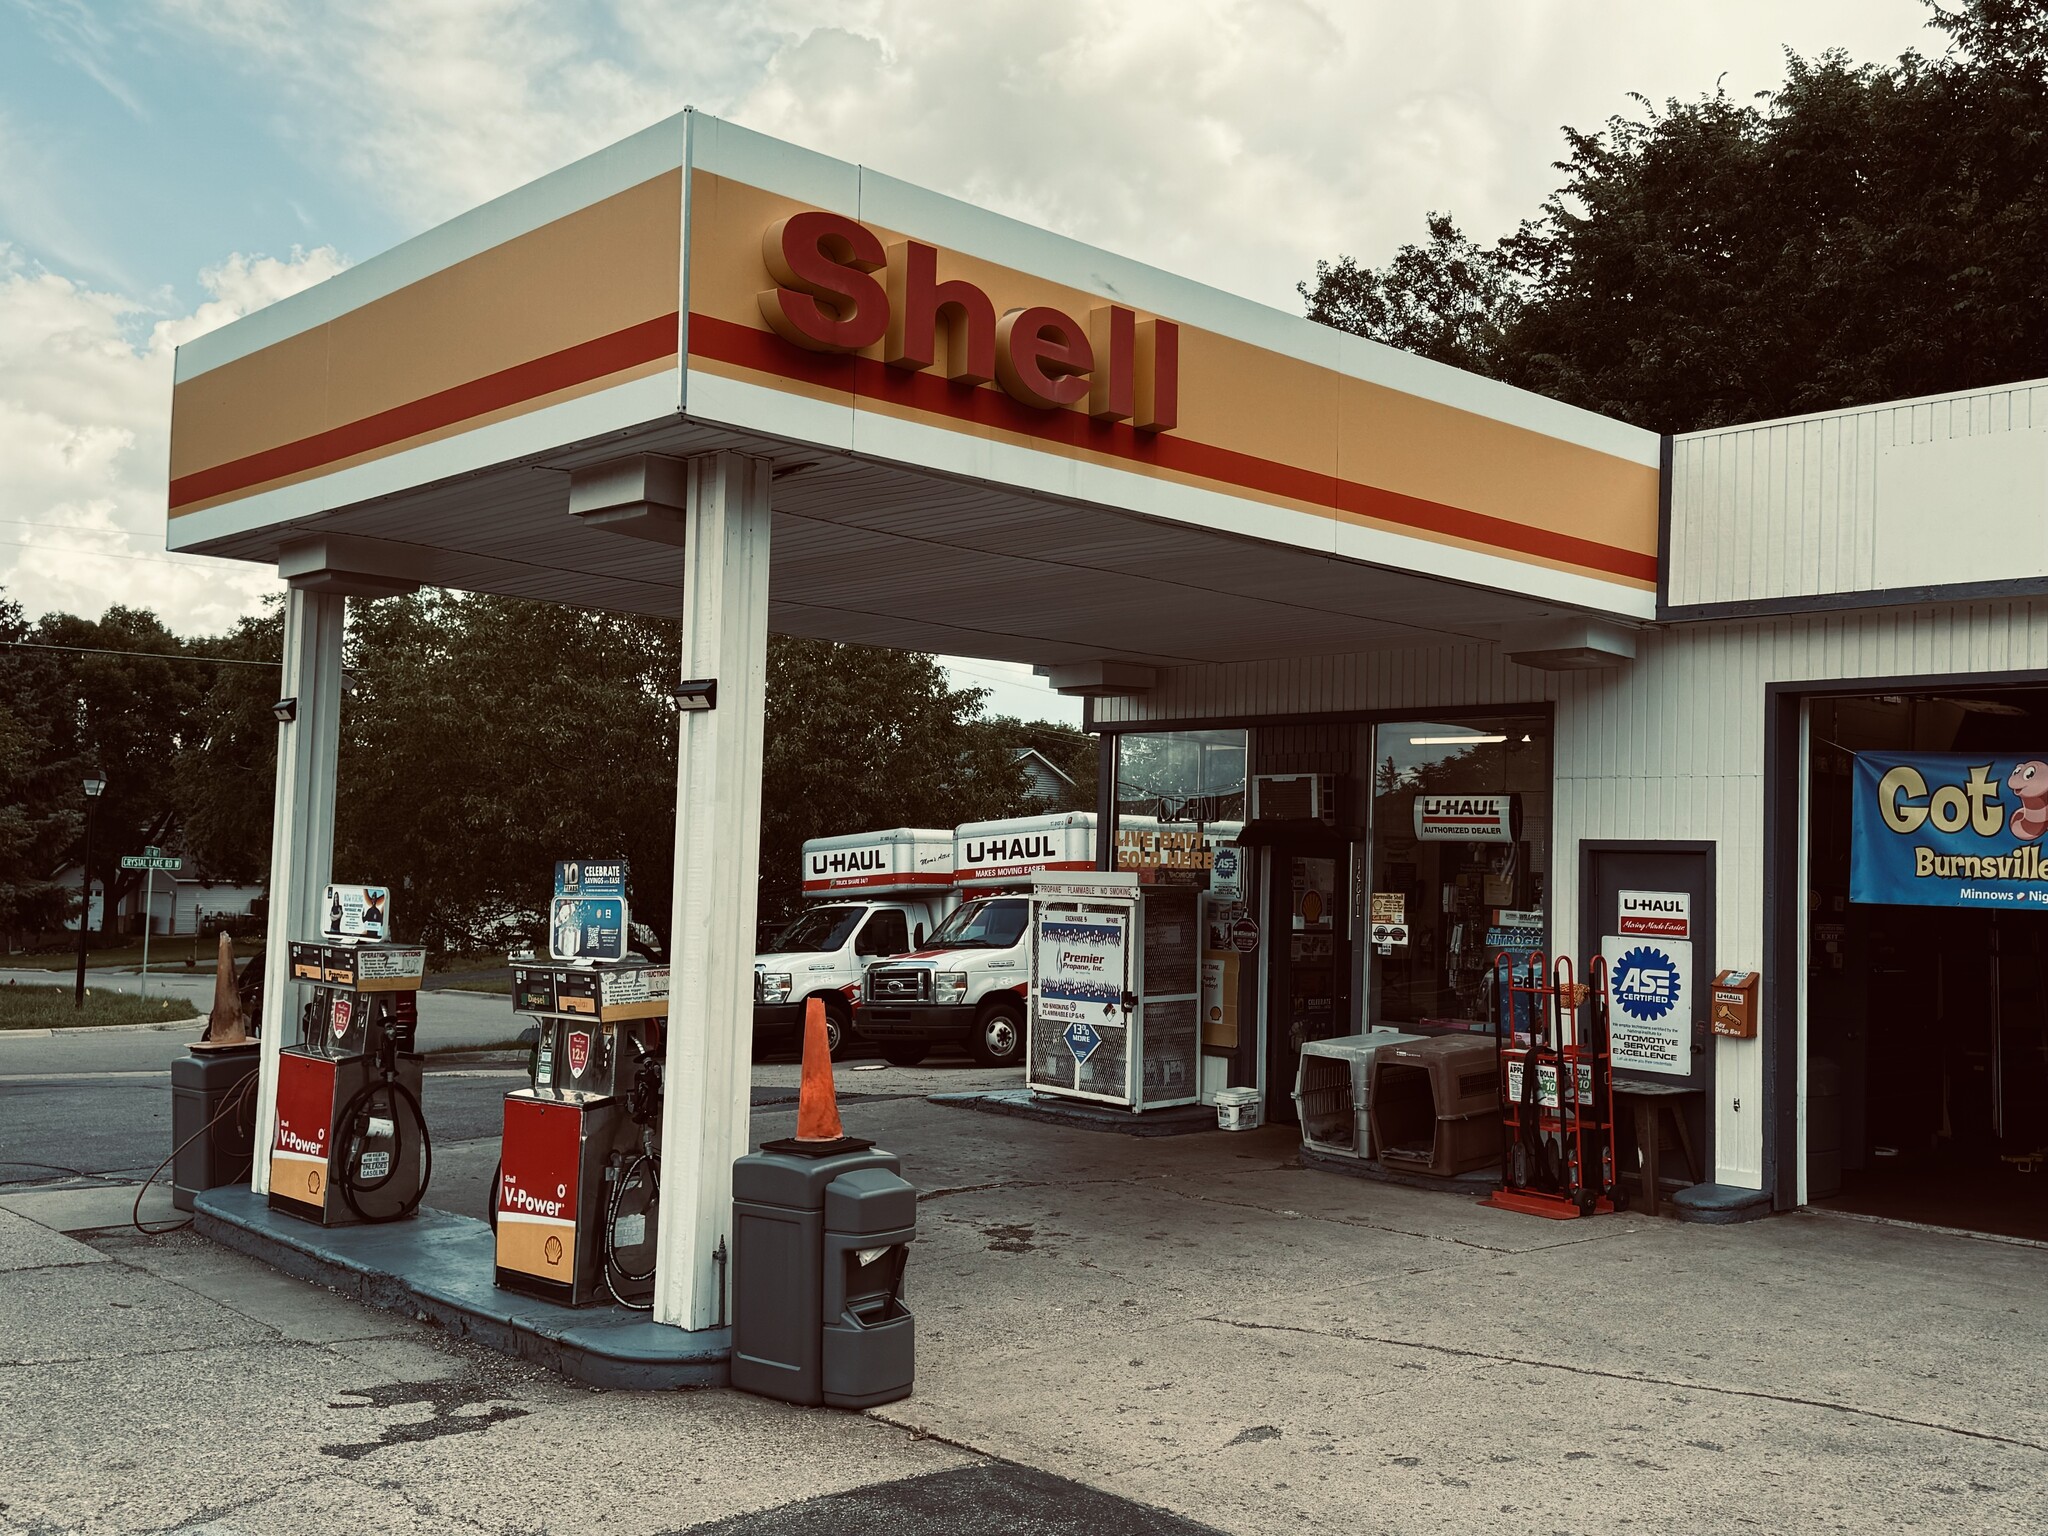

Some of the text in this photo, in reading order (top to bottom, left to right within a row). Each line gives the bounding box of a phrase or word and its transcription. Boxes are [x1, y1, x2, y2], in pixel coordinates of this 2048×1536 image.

[758, 211, 1179, 432] Shell
[1878, 761, 2005, 837] Got
[1159, 794, 1216, 821] OPEN
[1424, 799, 1499, 815] U-HAUL
[1424, 826, 1501, 835] AUTHORIZED DEALER
[1115, 830, 1203, 849] LIVE BAIT
[966, 836, 1056, 863] U-HAUL
[123, 858, 180, 868] CRYSTAL LAKE RD W
[812, 849, 886, 875] U-HAUL
[1118, 851, 1161, 868] SOLD
[1217, 858, 1234, 868] ASE
[1914, 842, 2048, 881] Burnsville
[563, 862, 579, 884] 10
[584, 865, 620, 877] CELEBRATE
[975, 865, 1046, 878] MAKES MOVING EASIER
[584, 877, 603, 885] SAVINGS
[1041, 885, 1061, 893] PROPANE
[1067, 886, 1095, 895] FLAMMABLE
[1100, 887, 1107, 895] NO
[1960, 888, 2014, 900] Minnows
[1624, 898, 1684, 912] U-HAUL
[1623, 920, 1646, 931] Moving
[1646, 921, 1664, 930] Made
[1063, 951, 1105, 964] Premier
[1062, 962, 1104, 972] Propane, Inc.
[328, 969, 350, 980] Premium
[1619, 967, 1670, 996] ASE
[527, 994, 545, 1004] Diesel
[1622, 993, 1668, 1004] CERTIFIED
[1717, 993, 1742, 1001] U-HAUL
[1073, 1023, 1090, 1035] 13%
[1715, 1026, 1729, 1034] Drop
[1072, 1034, 1090, 1043] MORE
[1612, 1033, 1678, 1046] AUTOMOTIVE
[1624, 1041, 1665, 1053] SERVICE
[1612, 1047, 1678, 1061] EXCELLENCE
[1576, 1068, 1590, 1076] OLLY
[1546, 1081, 1556, 1091] 10
[280, 1129, 322, 1156] V-Power
[362, 1162, 388, 1170] UNLEADED
[362, 1169, 387, 1177] GASOLINE
[504, 1174, 516, 1184] Shell
[504, 1185, 562, 1217] V-Power
